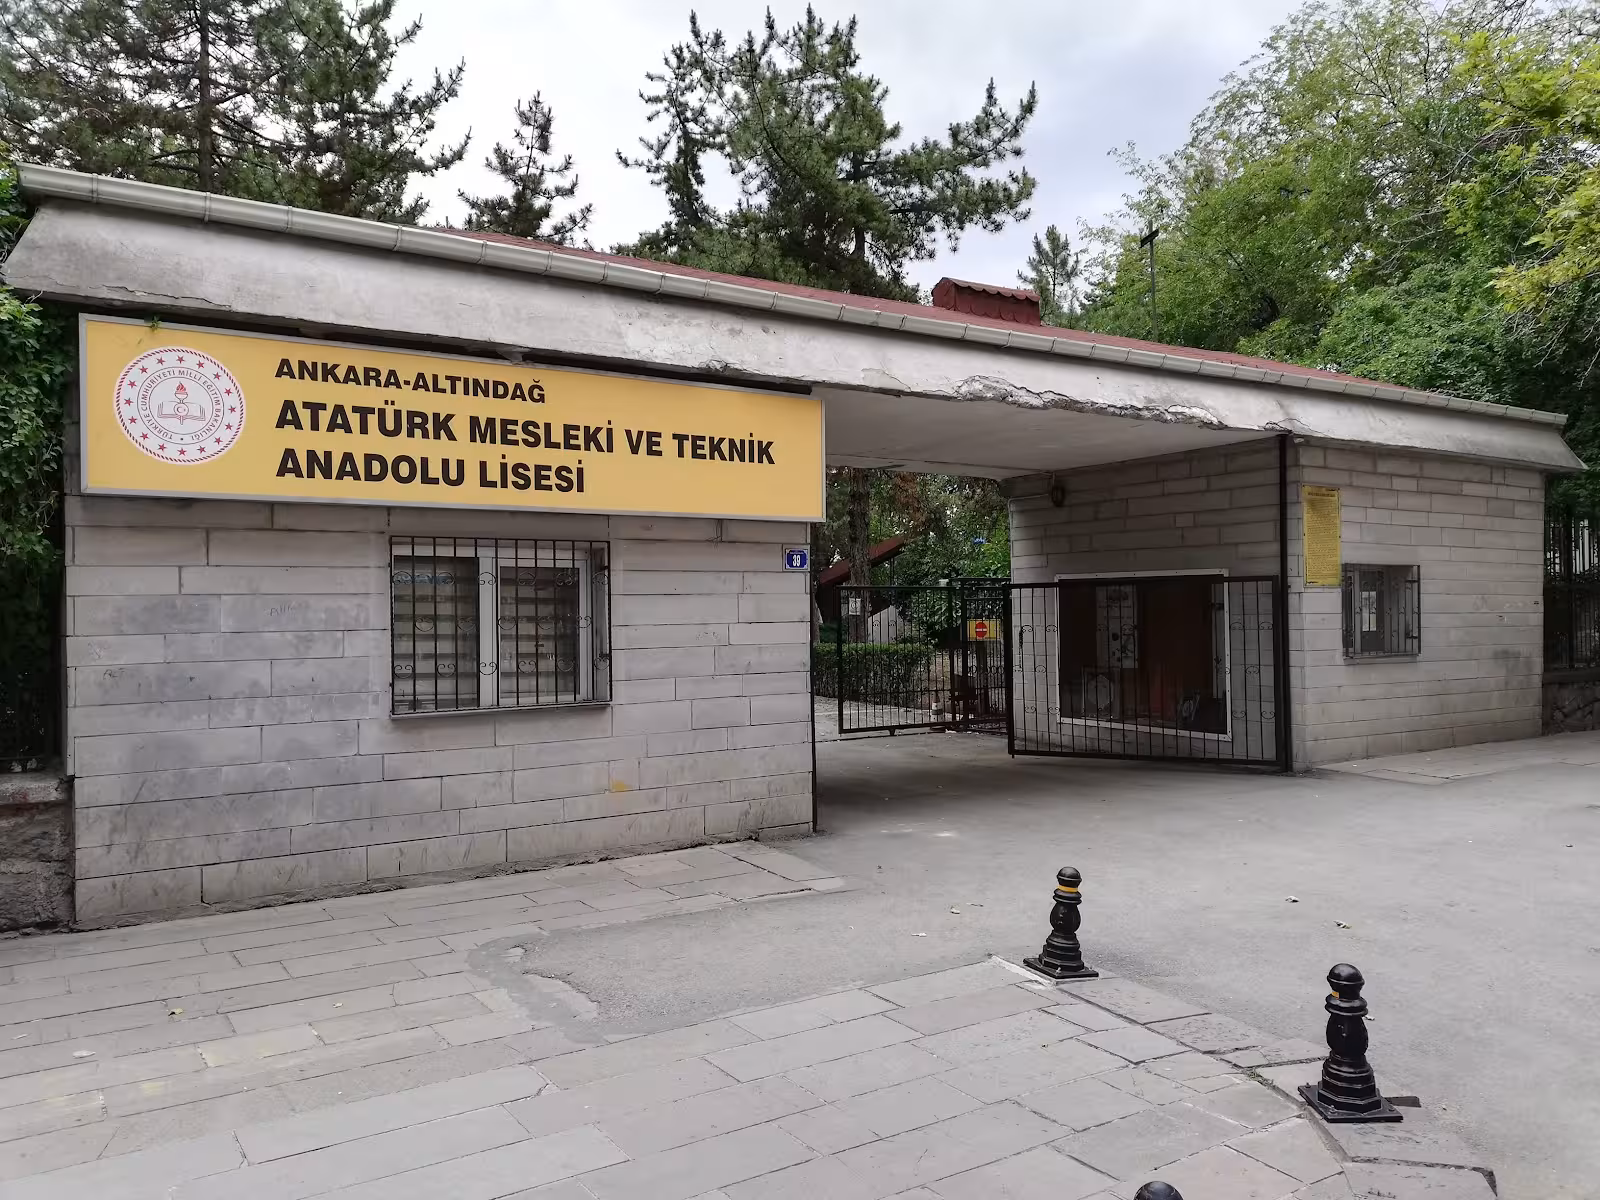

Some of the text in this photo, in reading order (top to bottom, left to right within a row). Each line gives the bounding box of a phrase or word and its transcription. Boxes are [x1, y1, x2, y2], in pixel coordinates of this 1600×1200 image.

[275, 358, 546, 404] ANKARA-ALTINDAĞ
[275, 399, 776, 465] ATATÜRK MESLEKİ VE TEKNİK
[276, 447, 585, 493] ANADOLU LİSESİ
[792, 554, 801, 567] 39
